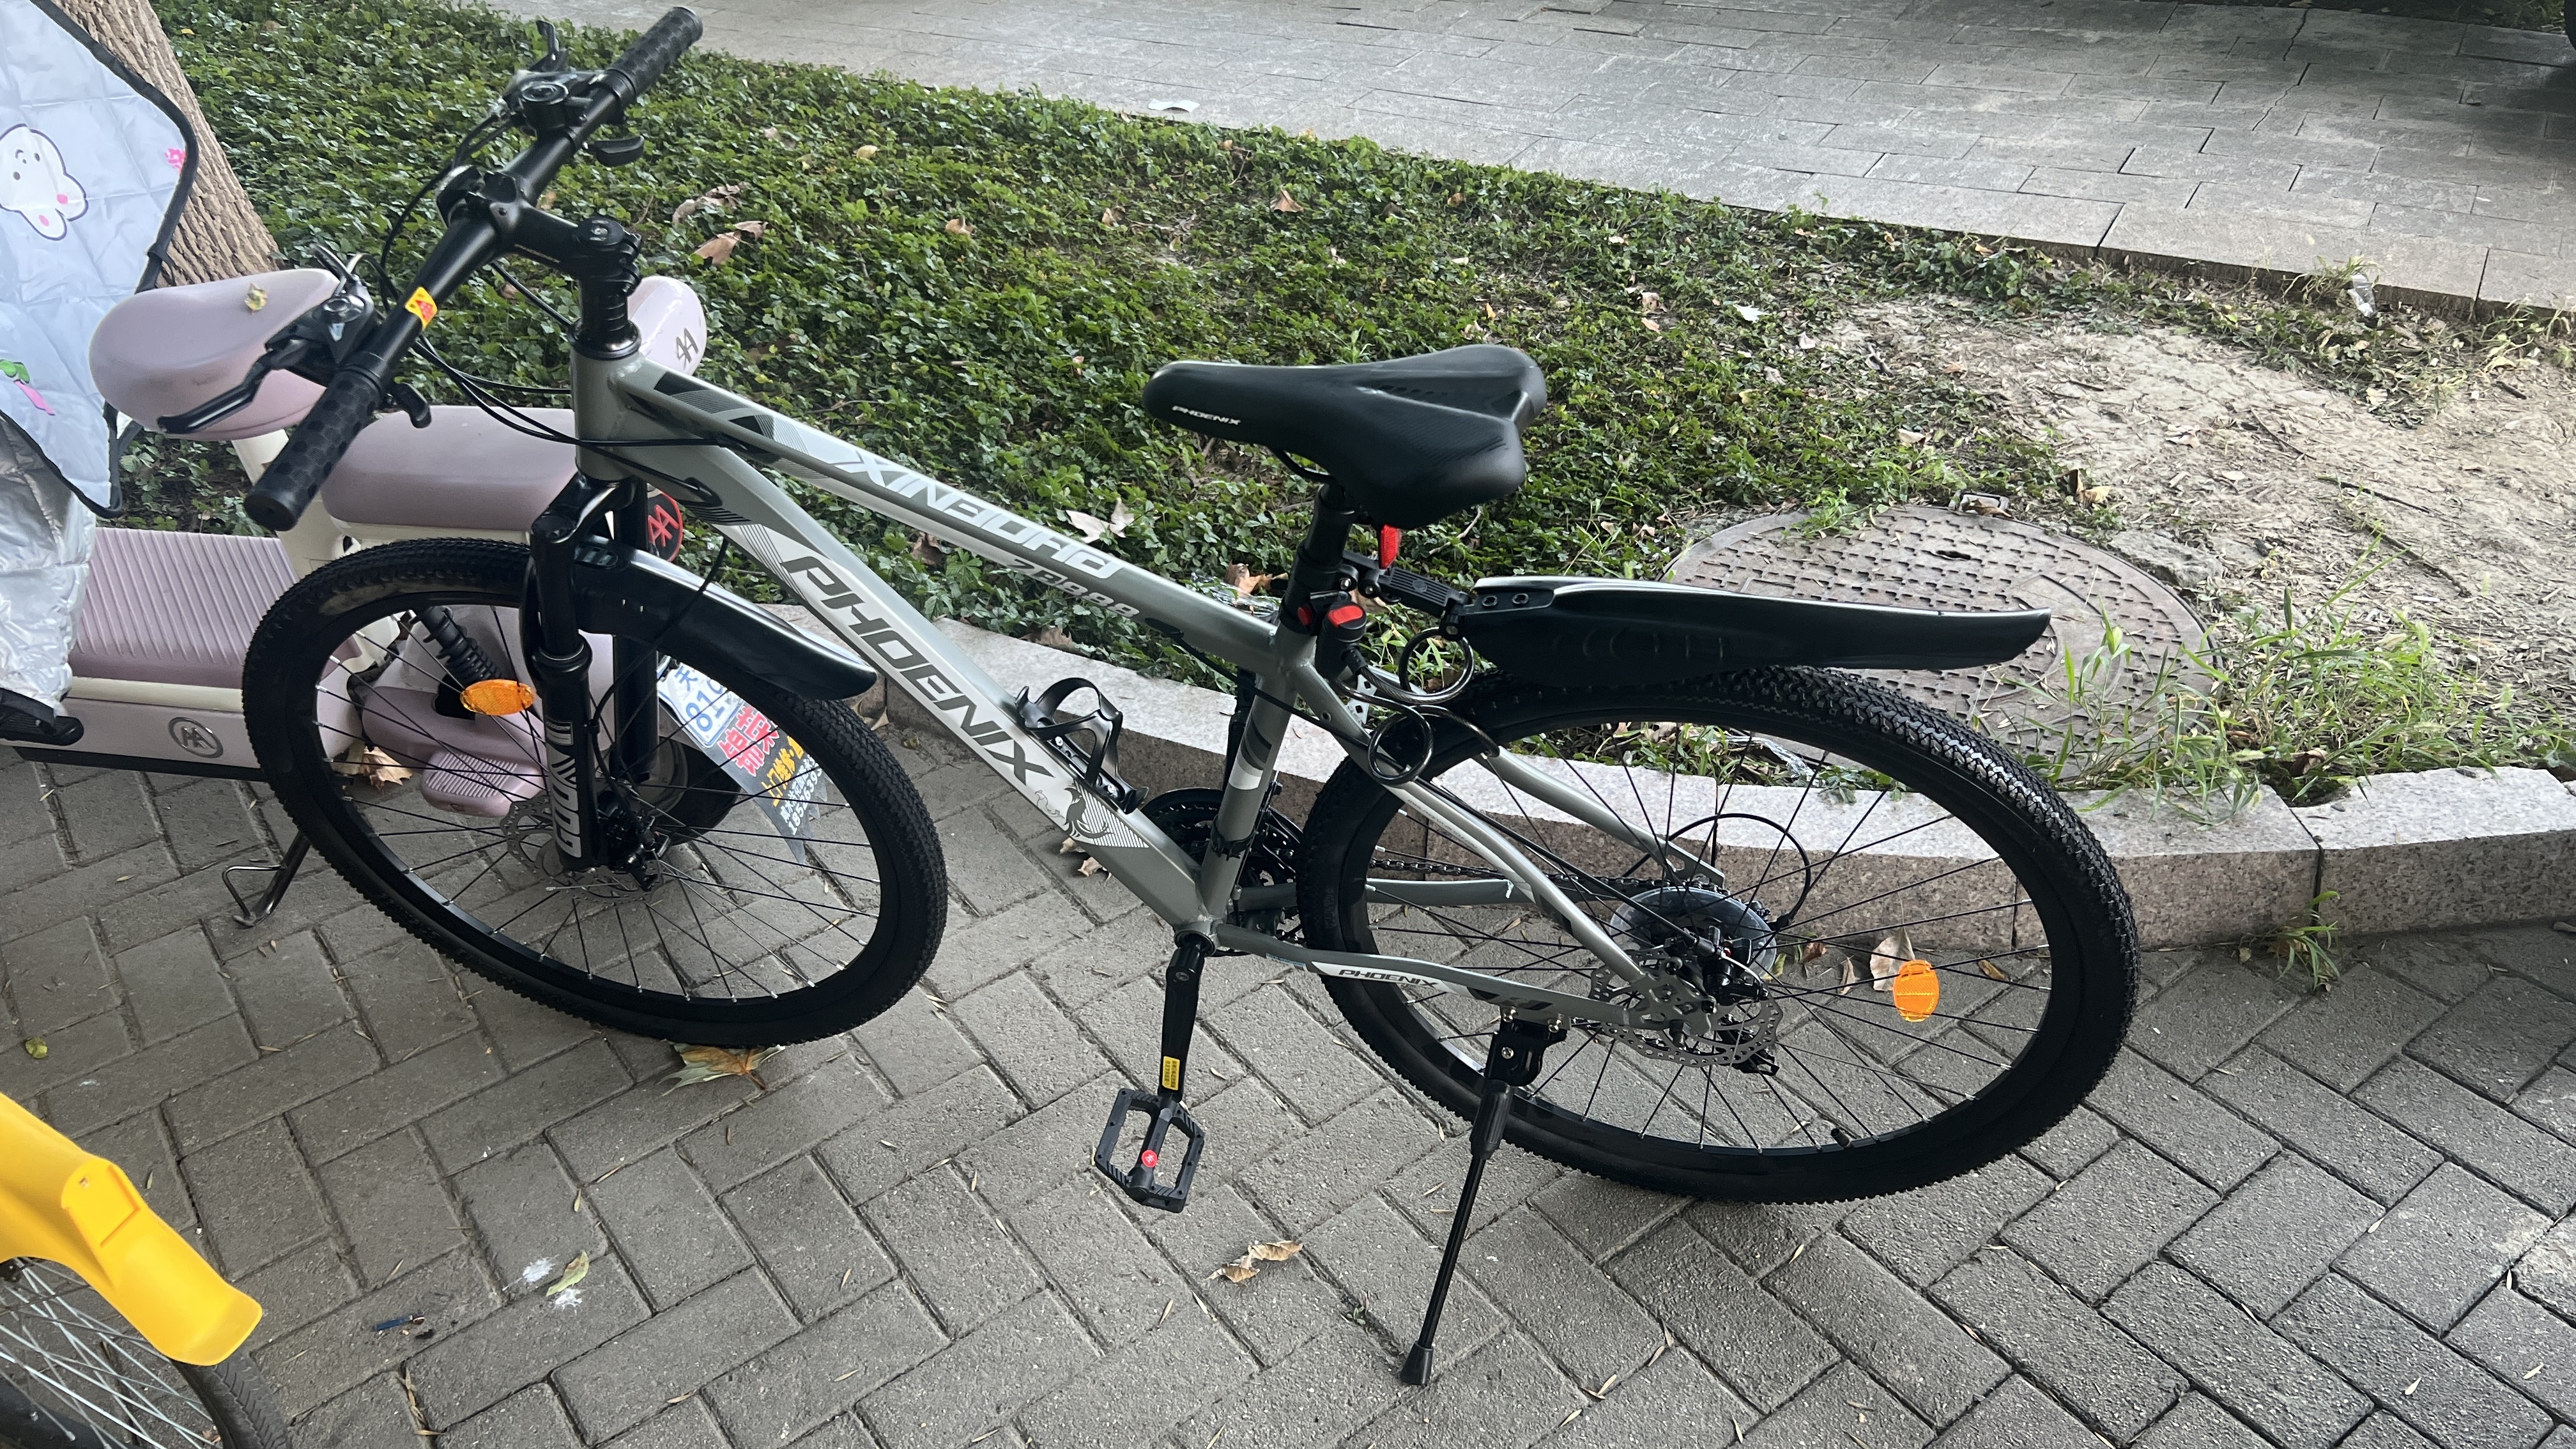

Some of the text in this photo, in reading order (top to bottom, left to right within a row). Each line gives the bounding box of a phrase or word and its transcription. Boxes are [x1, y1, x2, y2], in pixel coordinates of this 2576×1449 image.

[1172, 405, 1241, 425] PHOENIX
[834, 450, 1123, 579] PHOENIX
[780, 555, 1056, 786] PHOENIX
[717, 705, 780, 777] 锦荣
[1338, 969, 1439, 988] PHOENIX
